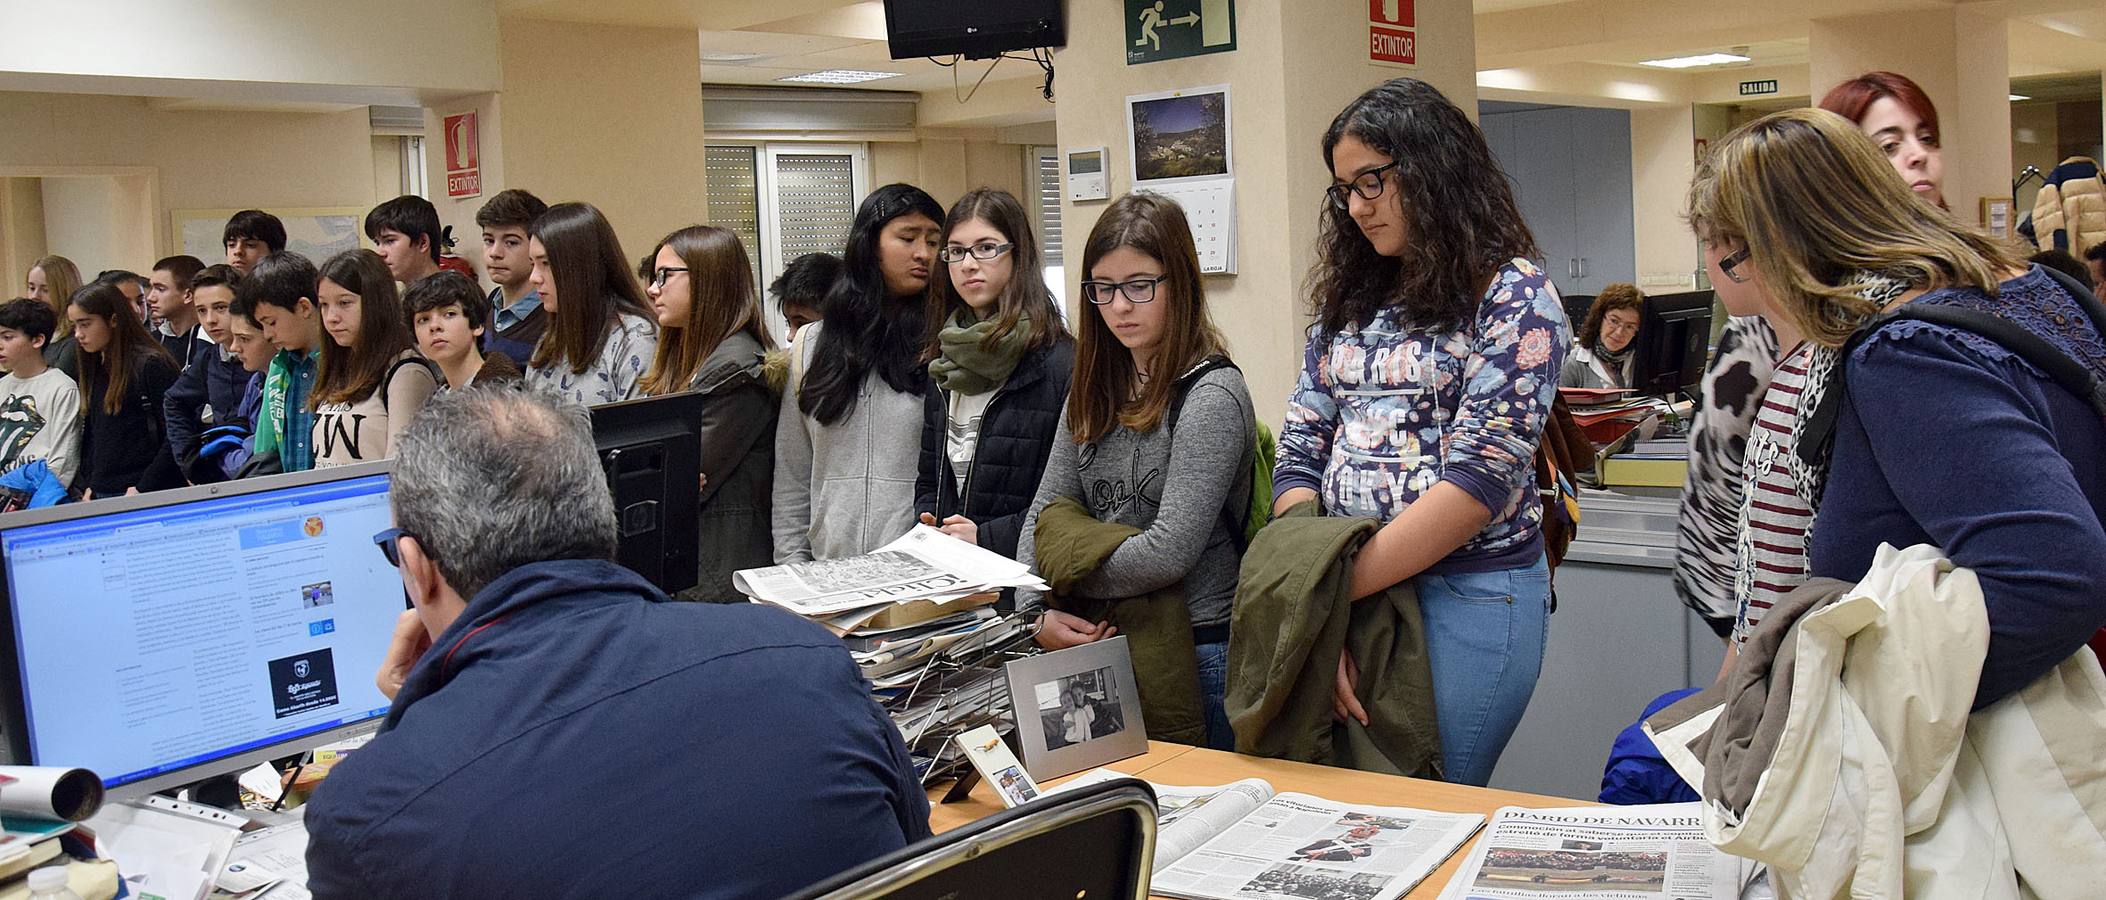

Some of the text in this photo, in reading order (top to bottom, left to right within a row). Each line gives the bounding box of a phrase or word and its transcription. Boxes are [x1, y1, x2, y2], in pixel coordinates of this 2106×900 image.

[1372, 33, 1414, 58] EXTINTOR
[1741, 82, 1775, 94] SALIDA
[449, 175, 479, 192] EXTINTOR
[1504, 812, 1704, 826] DIARIO DE NAVARR
[1498, 824, 1563, 832] Conmoción
[1560, 832, 1595, 840] forma
